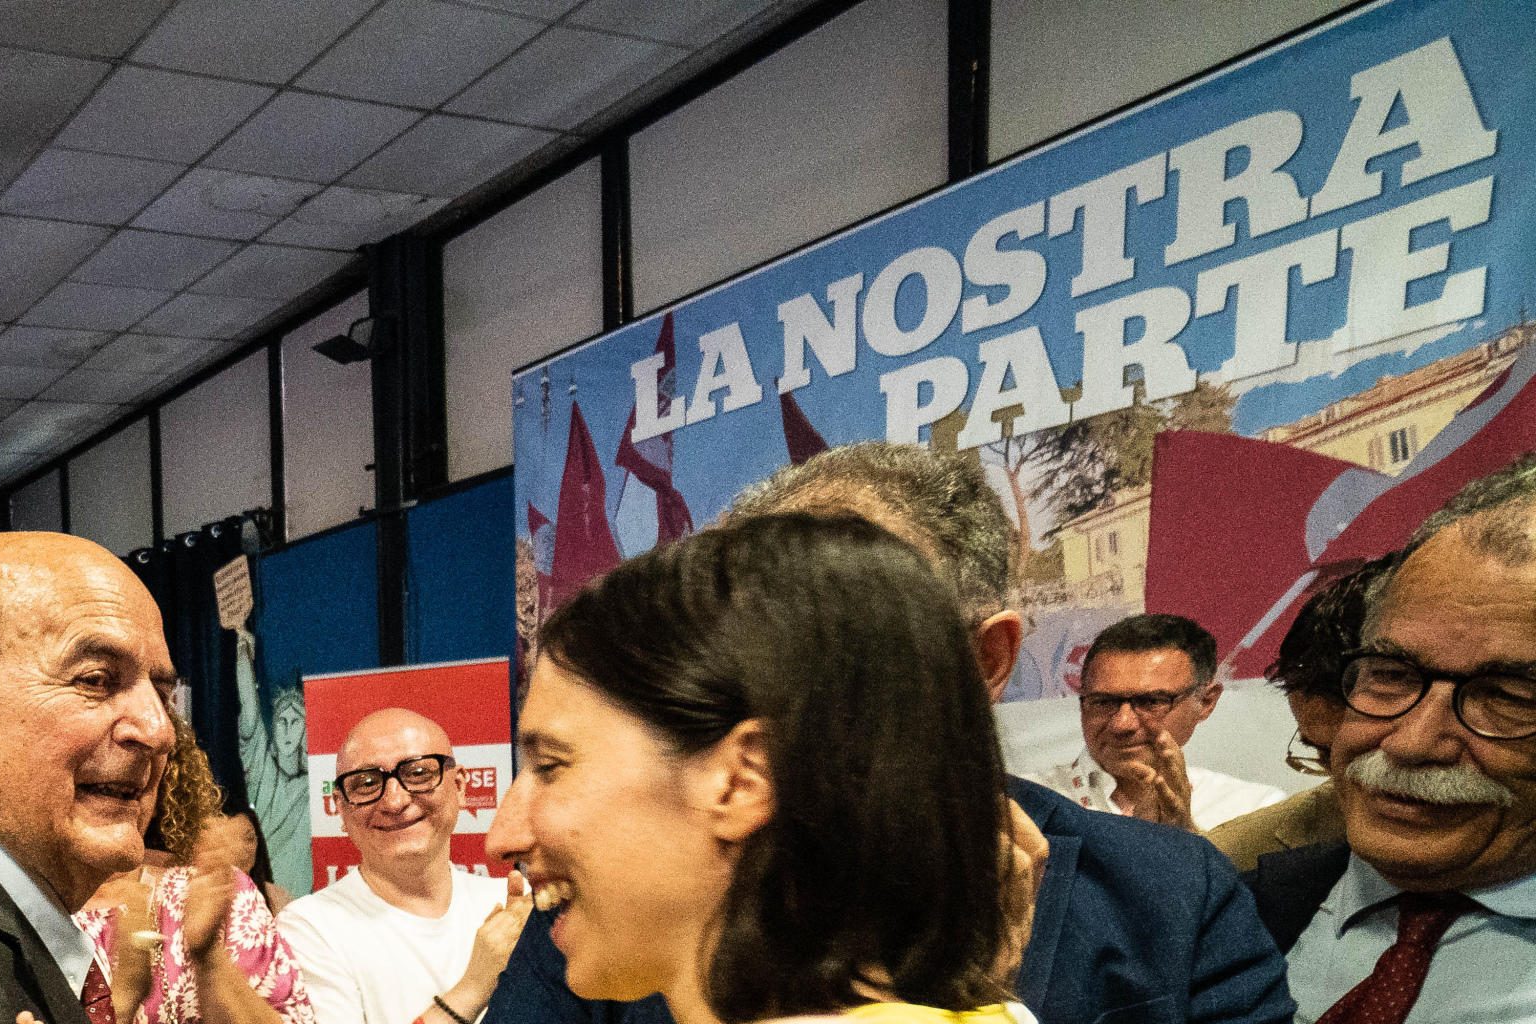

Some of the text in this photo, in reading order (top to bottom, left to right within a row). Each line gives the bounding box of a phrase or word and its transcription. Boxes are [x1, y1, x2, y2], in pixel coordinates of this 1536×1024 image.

[629, 35, 1497, 444] LA NOSTRA
[879, 175, 1494, 450] PARTE
